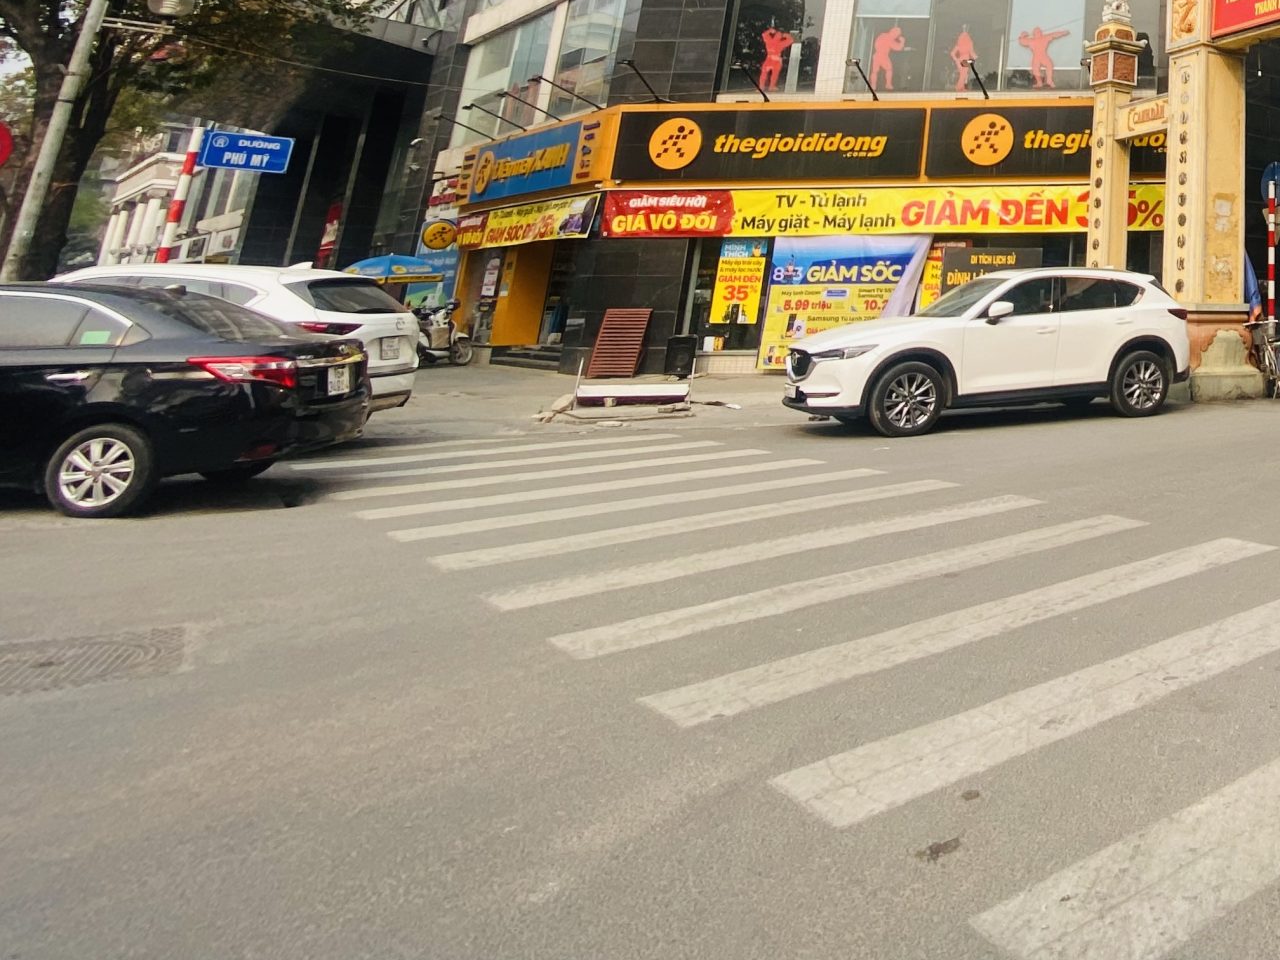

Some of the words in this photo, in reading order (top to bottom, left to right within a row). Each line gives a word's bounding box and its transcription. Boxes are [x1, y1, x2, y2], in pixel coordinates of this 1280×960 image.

[1254, 0, 1279, 16] THÀNH
[713, 133, 888, 159] thegioididong
[222, 151, 247, 165] PHÚ
[629, 195, 657, 208] GIẢM
[658, 195, 685, 207] SIÊU
[685, 195, 707, 208] HỜI
[776, 195, 797, 209] TV
[810, 193, 828, 208] Tủ
[832, 194, 868, 211] lạnh
[901, 191, 994, 227] GIẢM
[999, 190, 1069, 226] ĐẾN
[611, 210, 647, 233] GIÁ
[650, 210, 677, 231] VÔ
[680, 210, 718, 230] ĐỐI
[741, 215, 776, 232] Máy
[778, 214, 810, 233] giặt
[823, 213, 857, 232] Máy
[860, 215, 896, 231] lạnh
[970, 254, 978, 264] DI
[979, 253, 992, 264] TÍCH
[993, 254, 1006, 267] LỊCH
[1007, 252, 1016, 265] SỬ
[807, 260, 857, 282] GIẢM
[860, 260, 902, 282] SỐC
[947, 269, 971, 285] ĐÌNH
